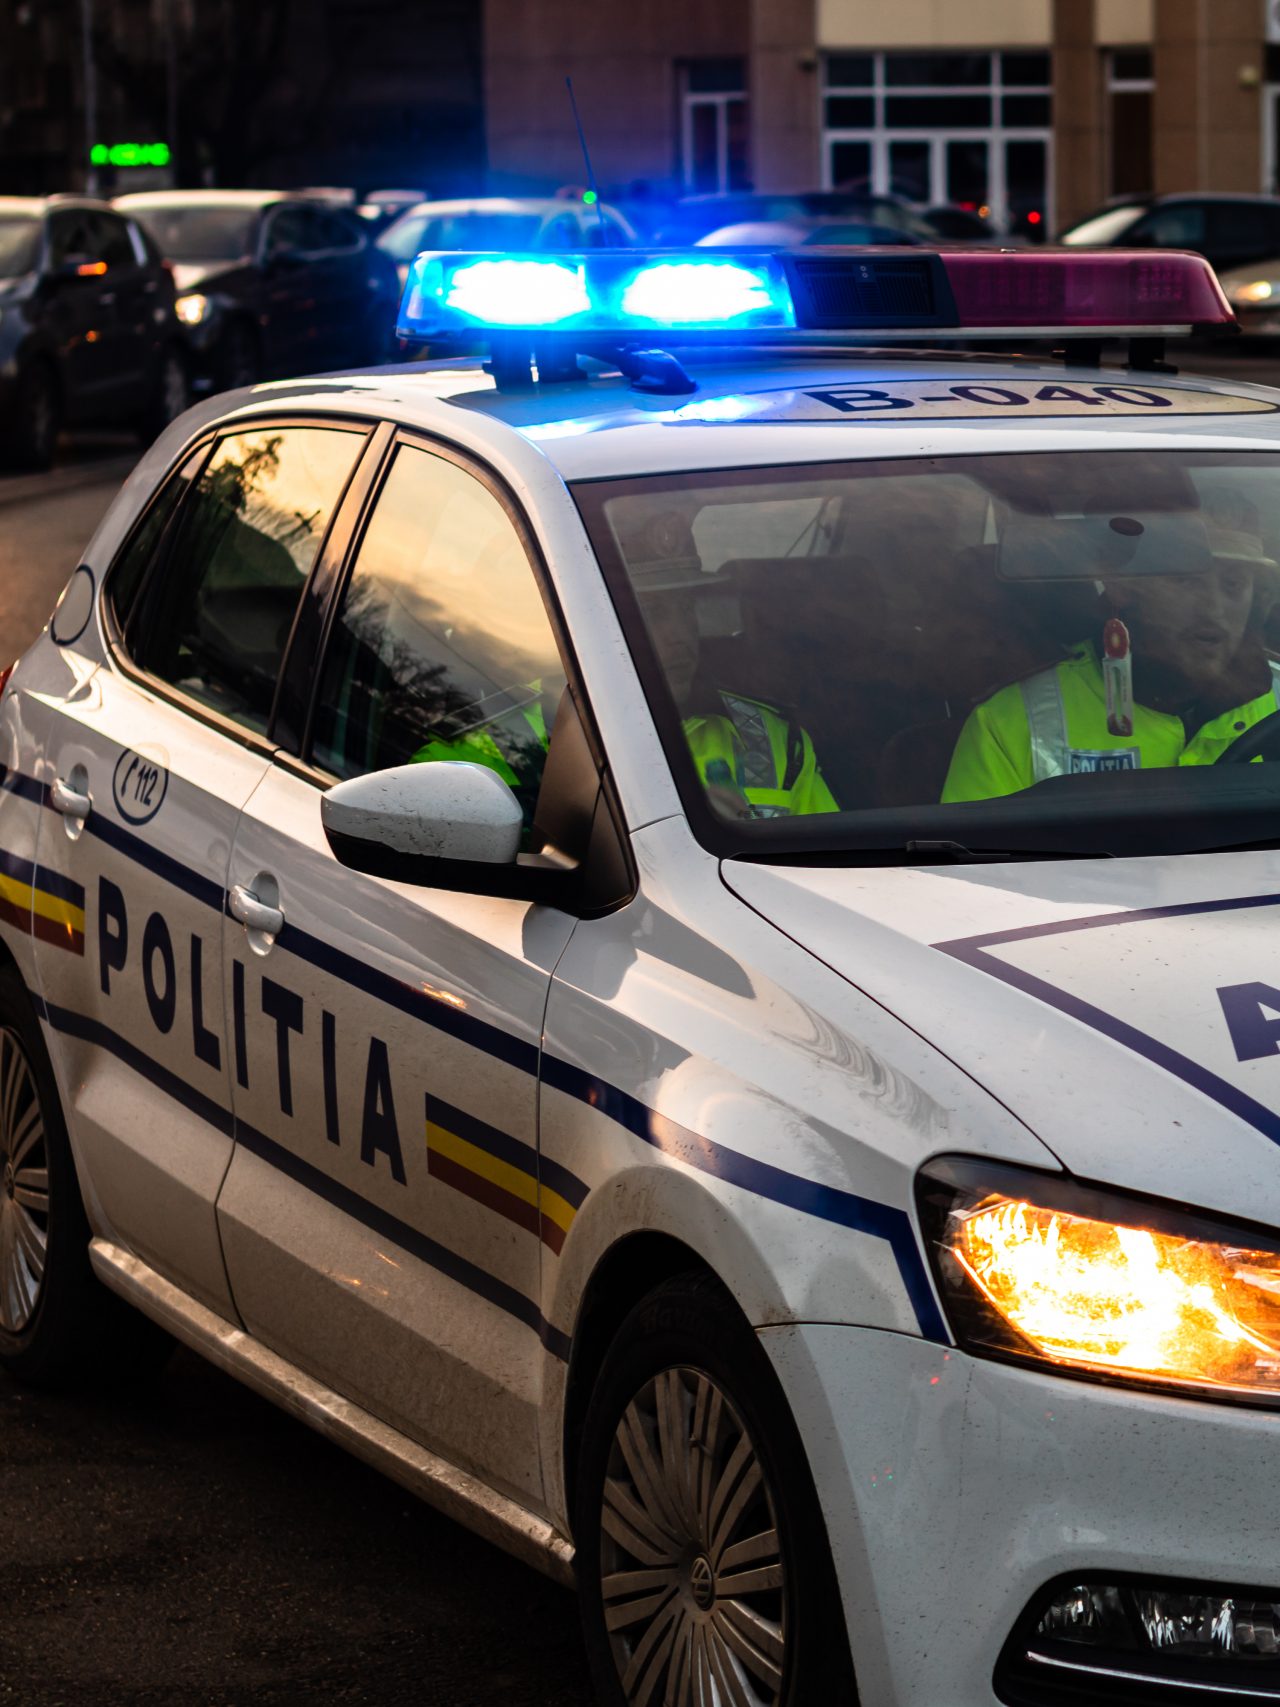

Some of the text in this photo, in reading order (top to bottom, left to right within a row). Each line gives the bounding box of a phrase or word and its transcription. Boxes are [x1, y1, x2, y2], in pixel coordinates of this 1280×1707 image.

[803, 386, 1173, 412] B-040
[134, 763, 158, 807] 112
[99, 875, 407, 1187] POLITIA
